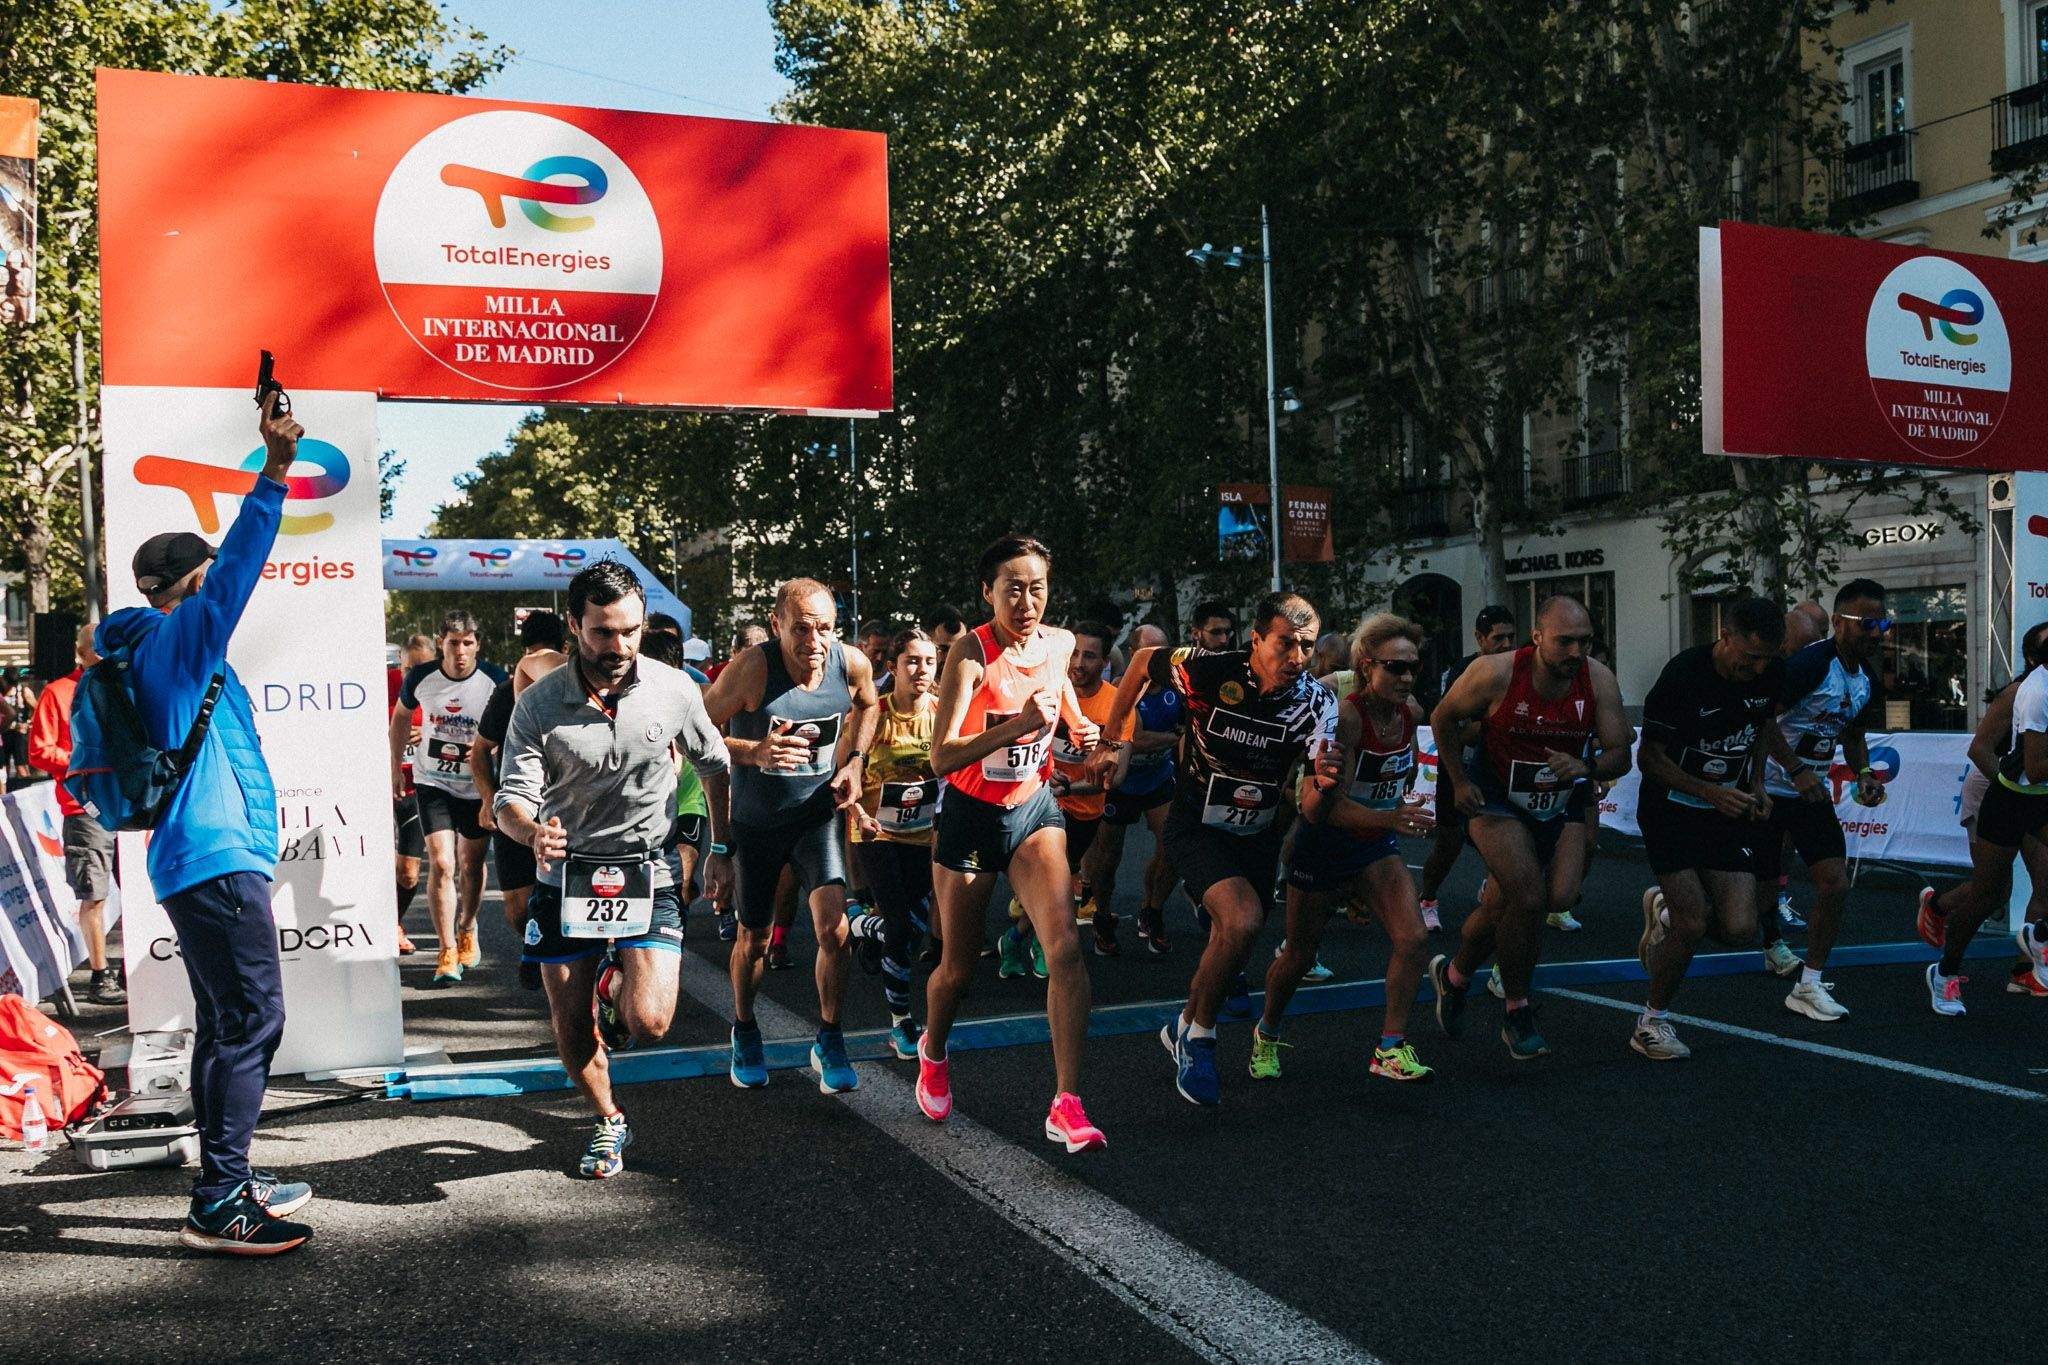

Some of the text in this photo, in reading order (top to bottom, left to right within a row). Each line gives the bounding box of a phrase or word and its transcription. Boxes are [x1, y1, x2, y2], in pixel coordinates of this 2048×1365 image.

[441, 244, 611, 274] TotalEnergies
[484, 295, 565, 317] MILLA
[455, 343, 595, 365] DE MADRID
[1899, 350, 1986, 375] TotalEnergies
[1923, 390, 1963, 406] MILLA
[1907, 423, 1978, 441] DE MADRID
[1221, 492, 1242, 501] ISLA
[1863, 523, 1936, 545] GEOX
[1565, 549, 1604, 568] KORS
[1222, 726, 1268, 749] ANDEAN
[437, 759, 461, 774] 224
[1008, 743, 1040, 768] 578
[1528, 792, 1559, 810] 387
[1225, 807, 1256, 825] 212
[586, 899, 629, 921] 232
